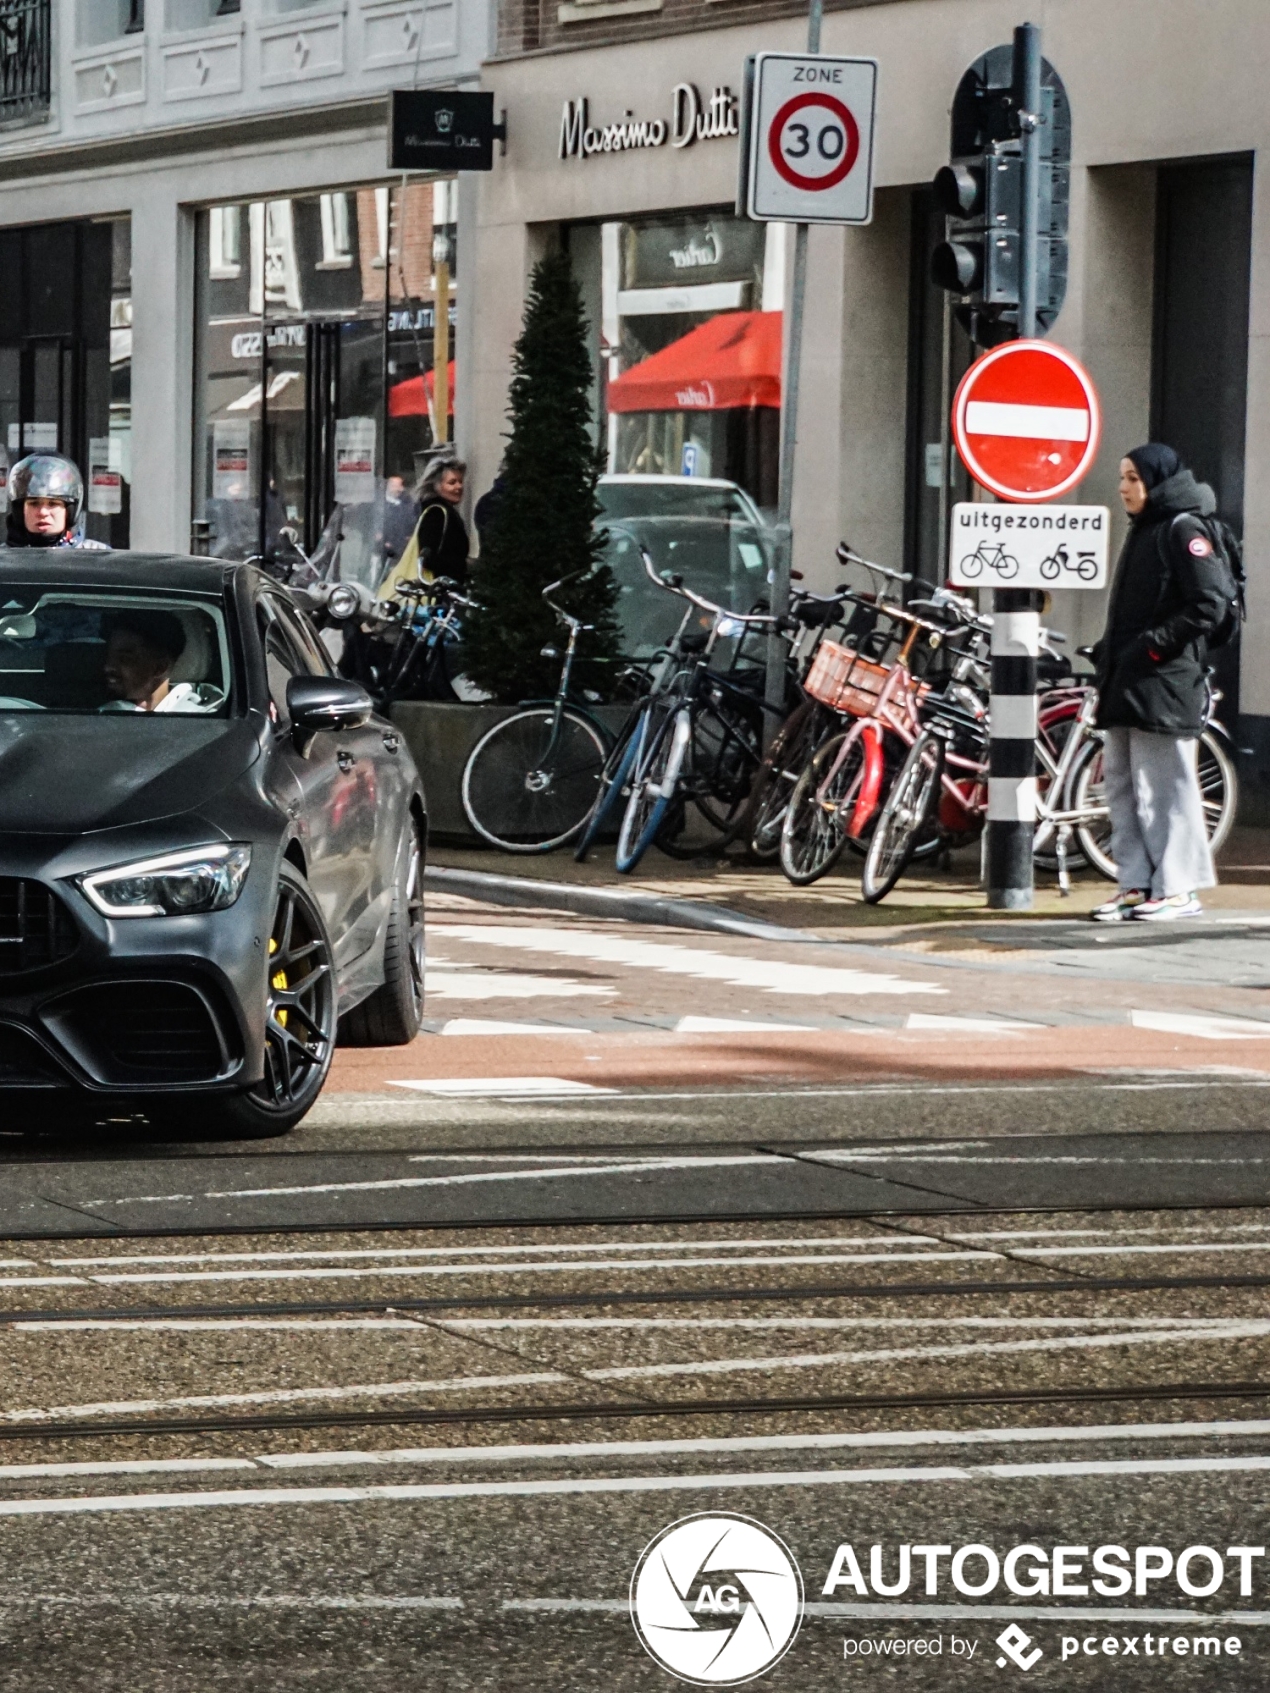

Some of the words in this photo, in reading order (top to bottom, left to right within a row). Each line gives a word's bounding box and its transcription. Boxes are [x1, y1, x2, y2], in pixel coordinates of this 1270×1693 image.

[793, 67, 843, 84] ZONE
[558, 97, 669, 159] Massimo
[671, 83, 739, 148] Dutti
[784, 123, 844, 160] 30
[960, 511, 1102, 533] uitgezonderd
